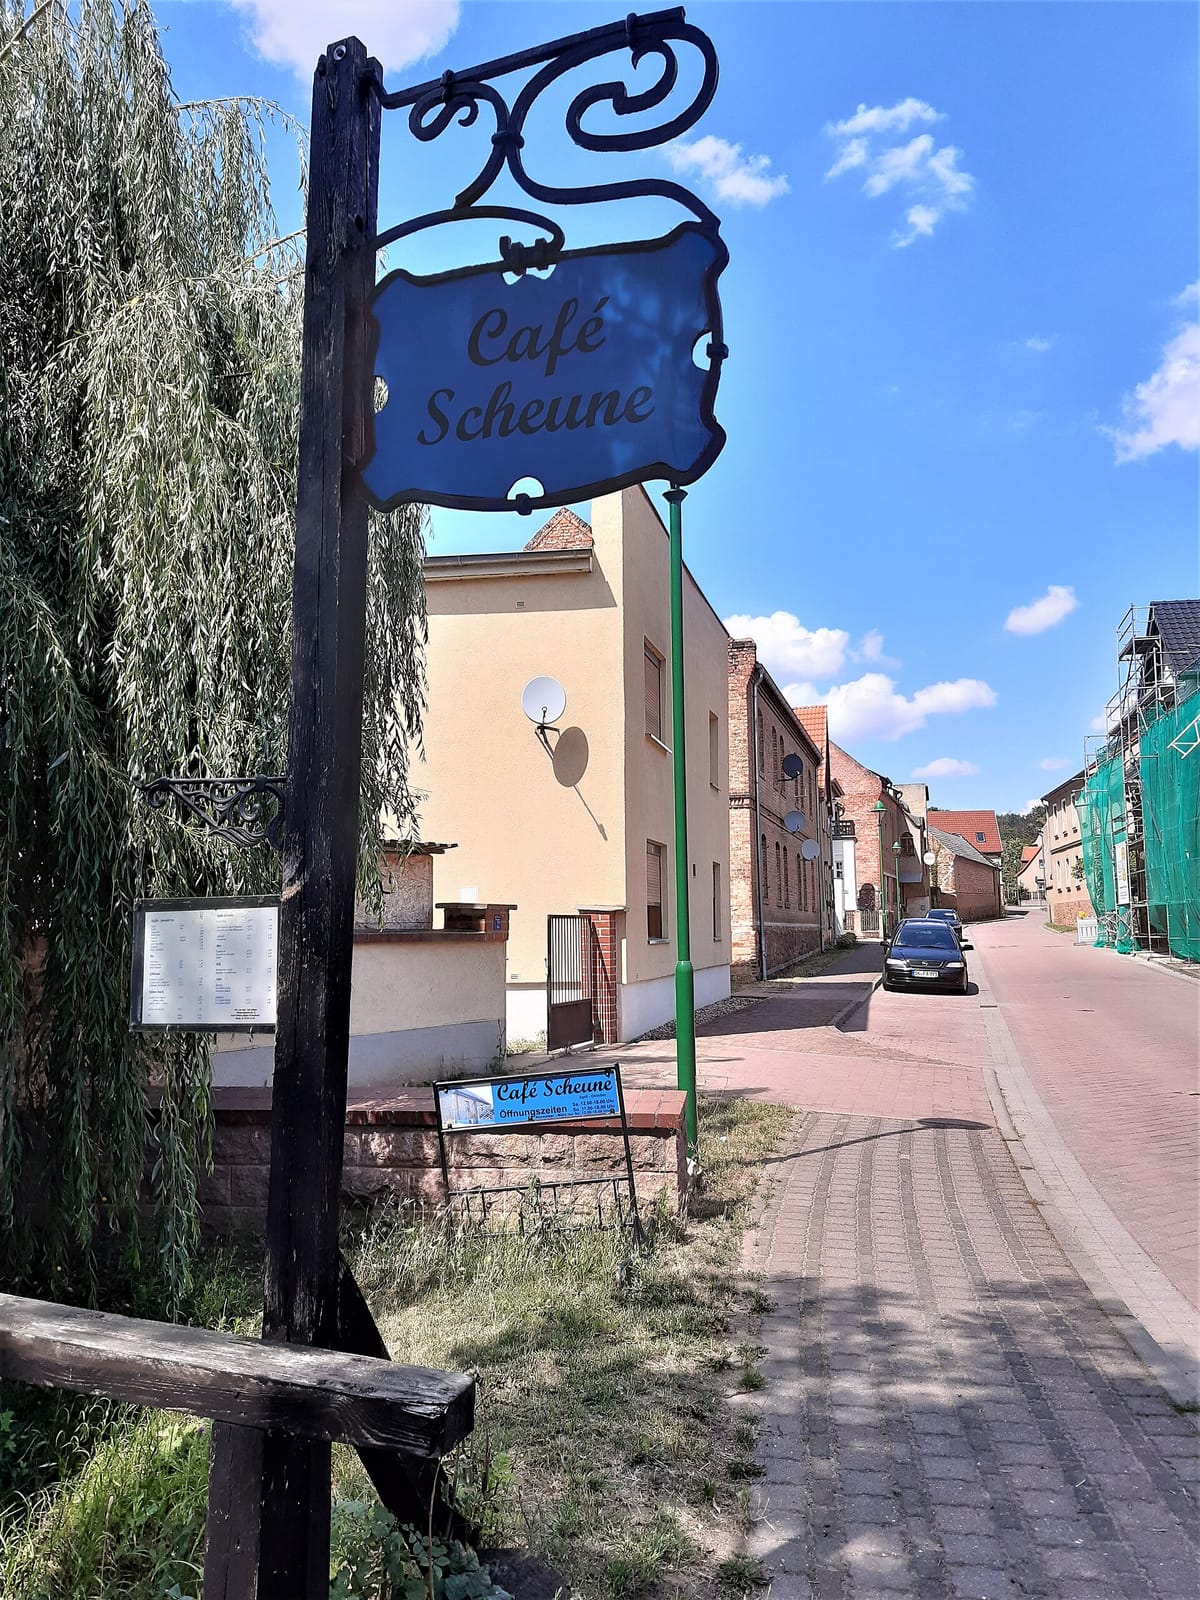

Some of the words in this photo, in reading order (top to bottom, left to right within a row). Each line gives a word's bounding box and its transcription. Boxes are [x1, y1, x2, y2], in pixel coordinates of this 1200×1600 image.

[467, 295, 611, 377] Café
[416, 381, 655, 446] Scheune
[497, 1080, 538, 1104] Café
[543, 1077, 612, 1097] Scheune
[499, 1105, 567, 1118] Öffnungszeiten
